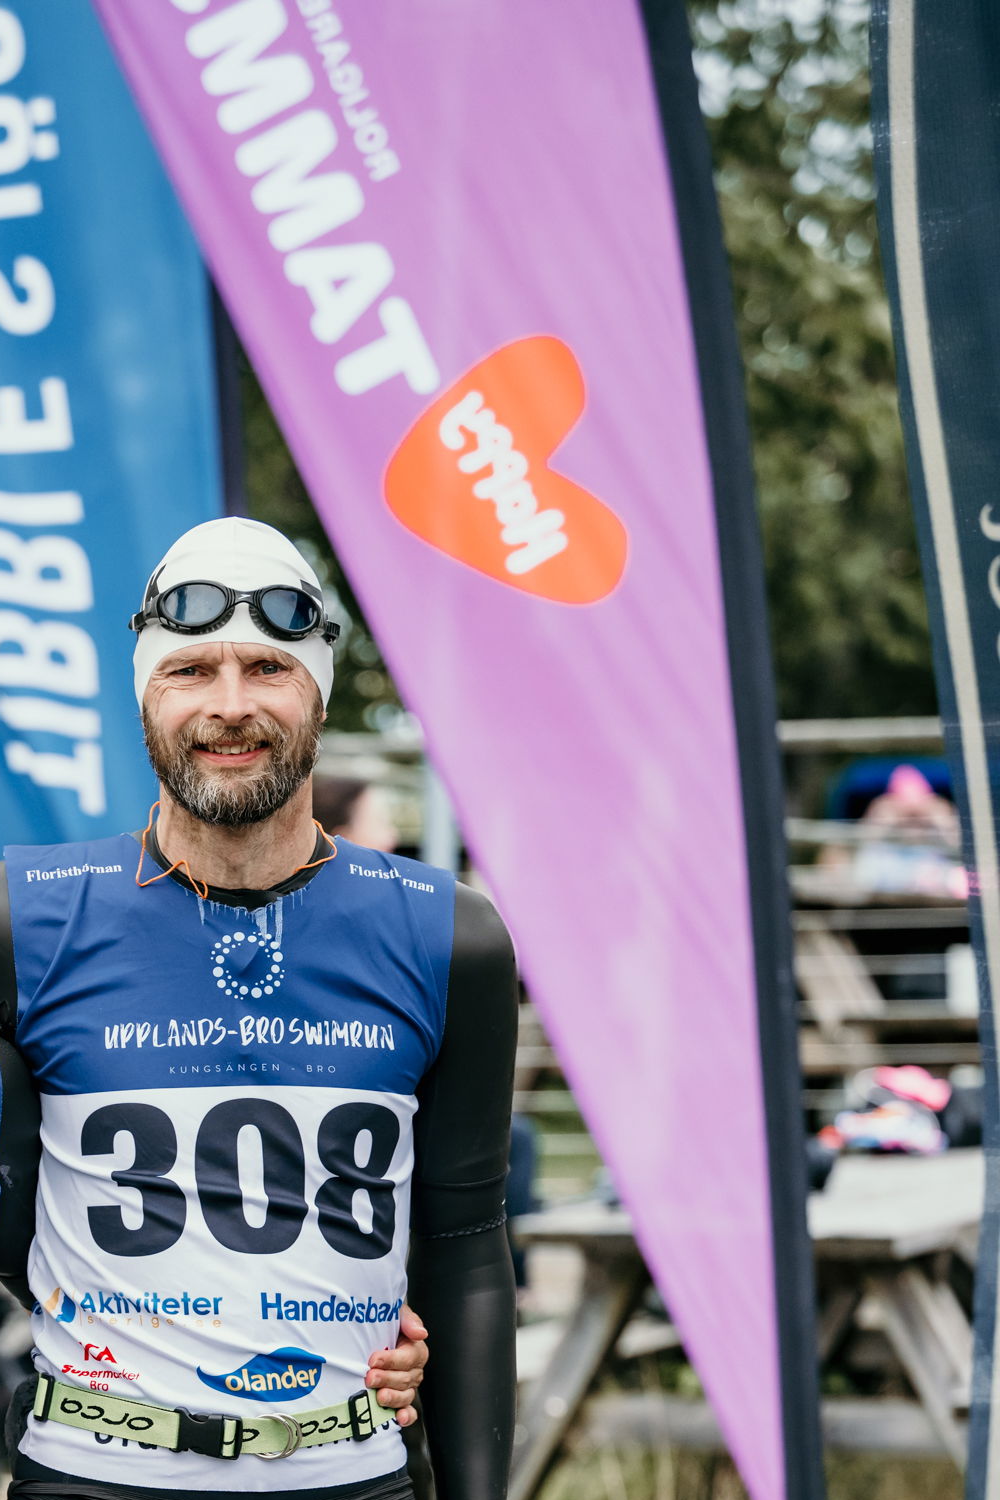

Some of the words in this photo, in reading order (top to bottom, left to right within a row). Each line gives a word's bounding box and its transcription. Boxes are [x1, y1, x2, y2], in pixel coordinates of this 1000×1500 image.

[349, 863, 435, 893] Floristhrnan
[289, 1018, 395, 1051] SWIMRUN
[169, 1063, 281, 1075] KUNGSÄNGEN
[306, 1064, 337, 1074] BRO
[80, 1097, 401, 1260] 308
[89, 1380, 109, 1392] Bro
[224, 1364, 319, 1392] olander
[59, 1397, 155, 1431] orca
